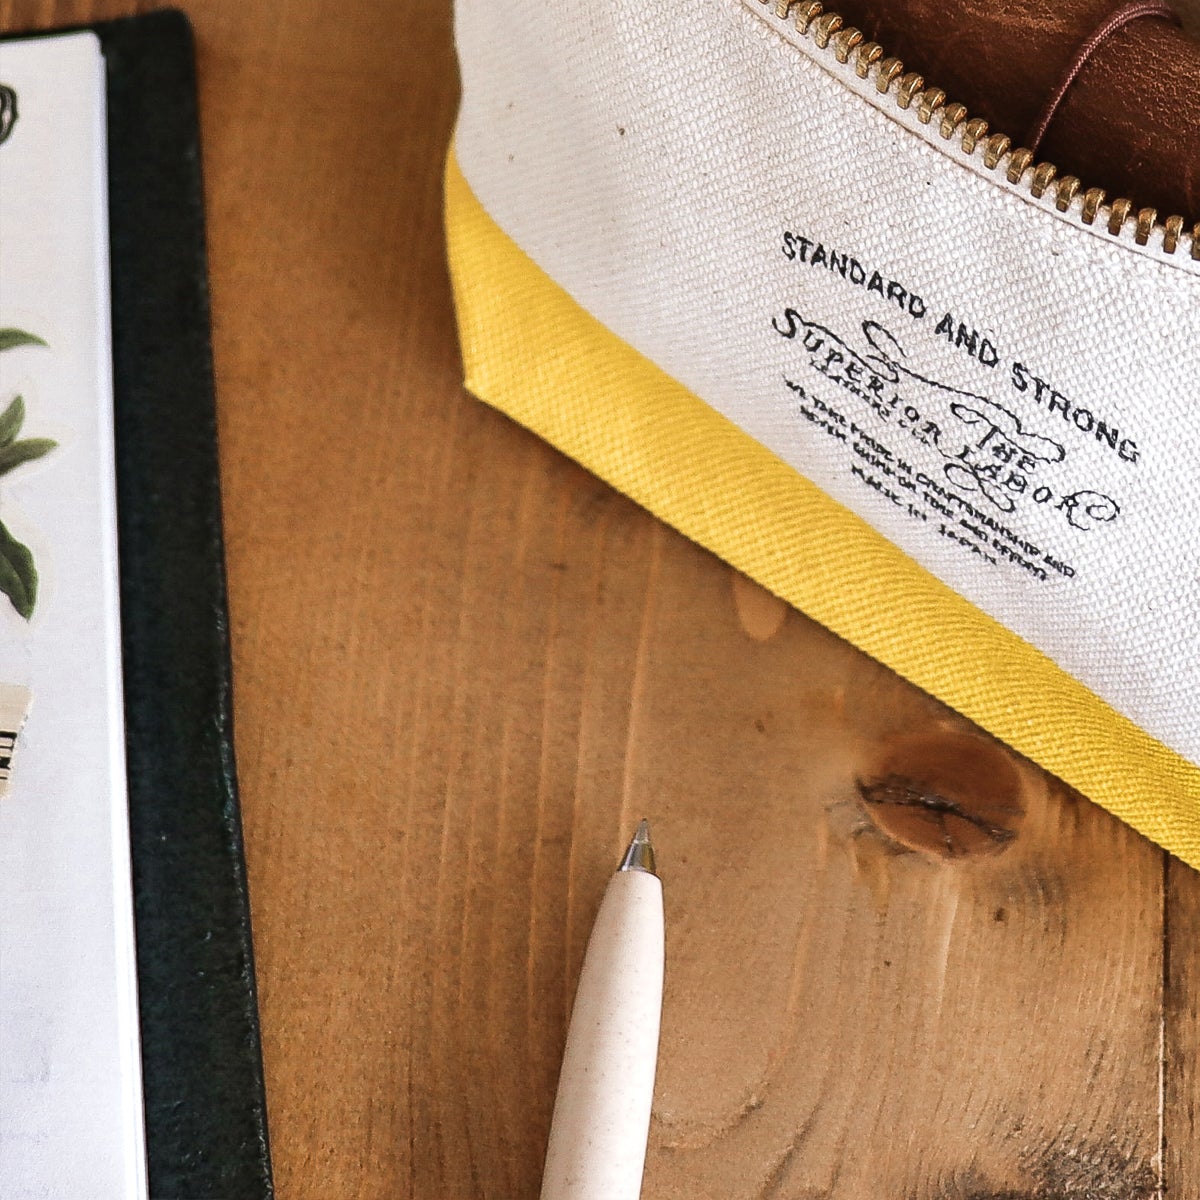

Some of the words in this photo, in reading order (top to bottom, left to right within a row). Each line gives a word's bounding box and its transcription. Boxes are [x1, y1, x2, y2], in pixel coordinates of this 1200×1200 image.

[771, 307, 942, 446] SUPERIOR
[957, 443, 1120, 532] LABOR
[782, 231, 927, 320] STANDARD
[935, 313, 999, 369] AND
[1011, 362, 1140, 465] STRONG
[915, 472, 1041, 556] CRAFTSMANSHIP
